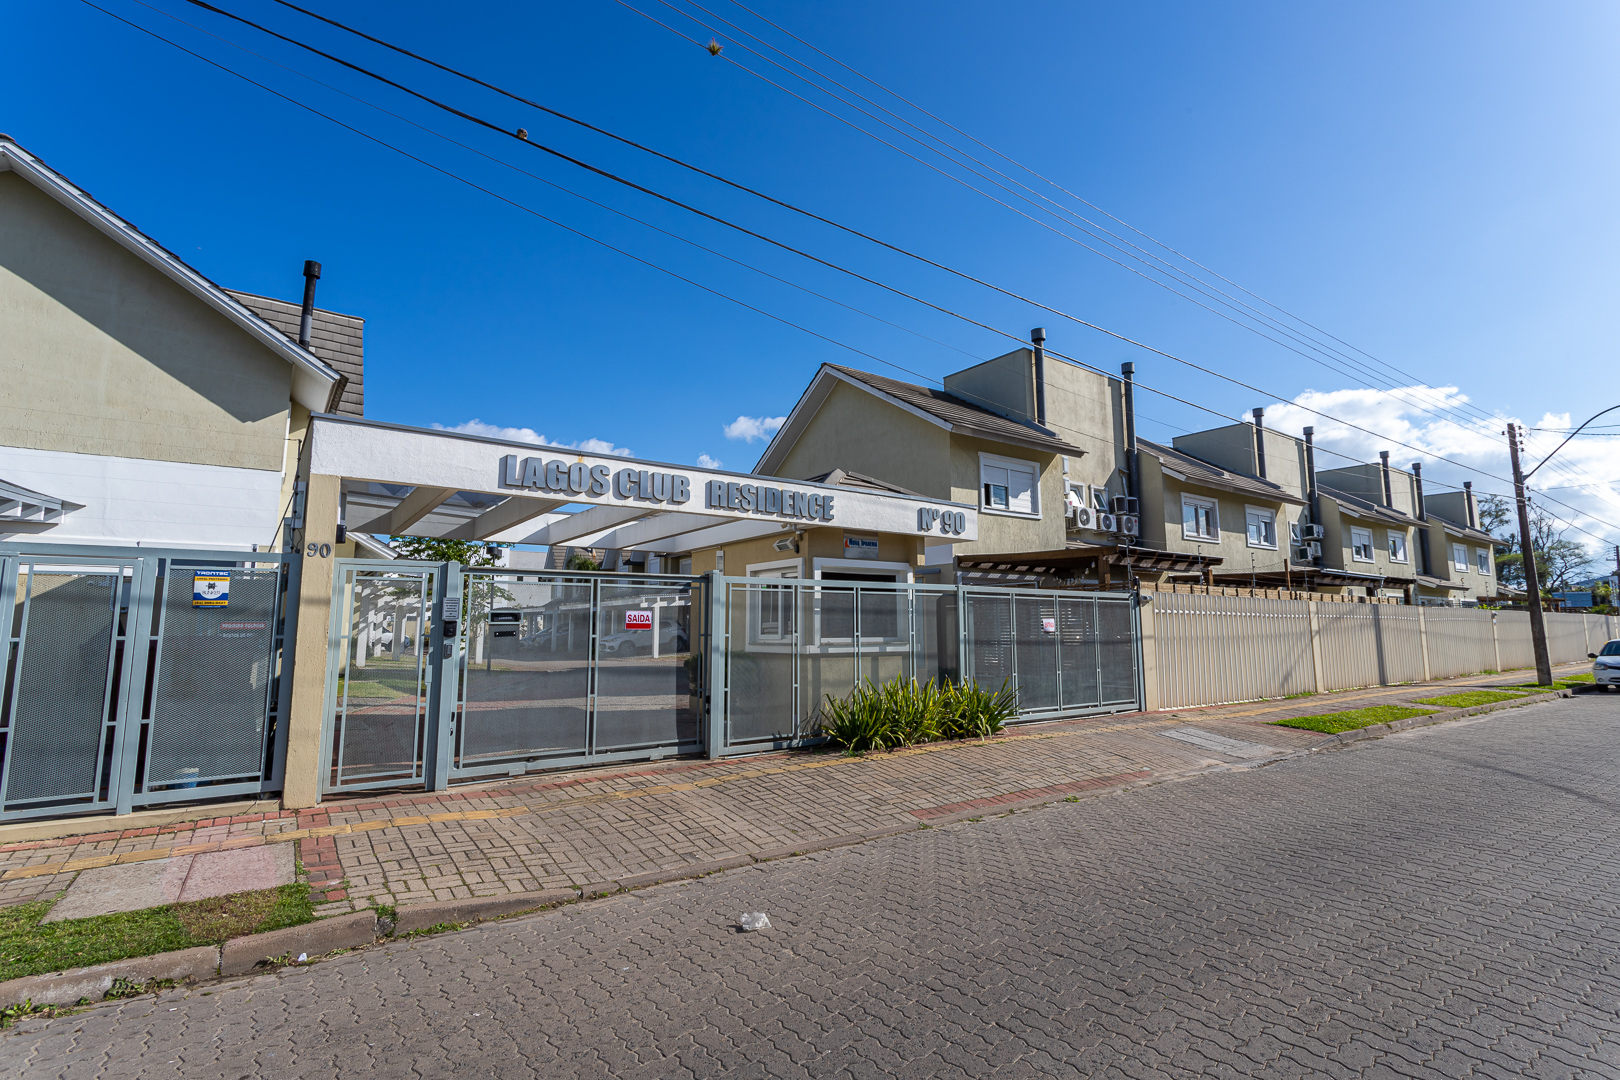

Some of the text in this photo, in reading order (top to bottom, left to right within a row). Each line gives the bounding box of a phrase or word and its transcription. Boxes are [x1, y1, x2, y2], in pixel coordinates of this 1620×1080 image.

[504, 454, 835, 520] LAGOS CLUB RESIDENCE
[942, 511, 966, 535] 90
[307, 542, 332, 558] 90
[627, 612, 650, 623] SAÍDA
